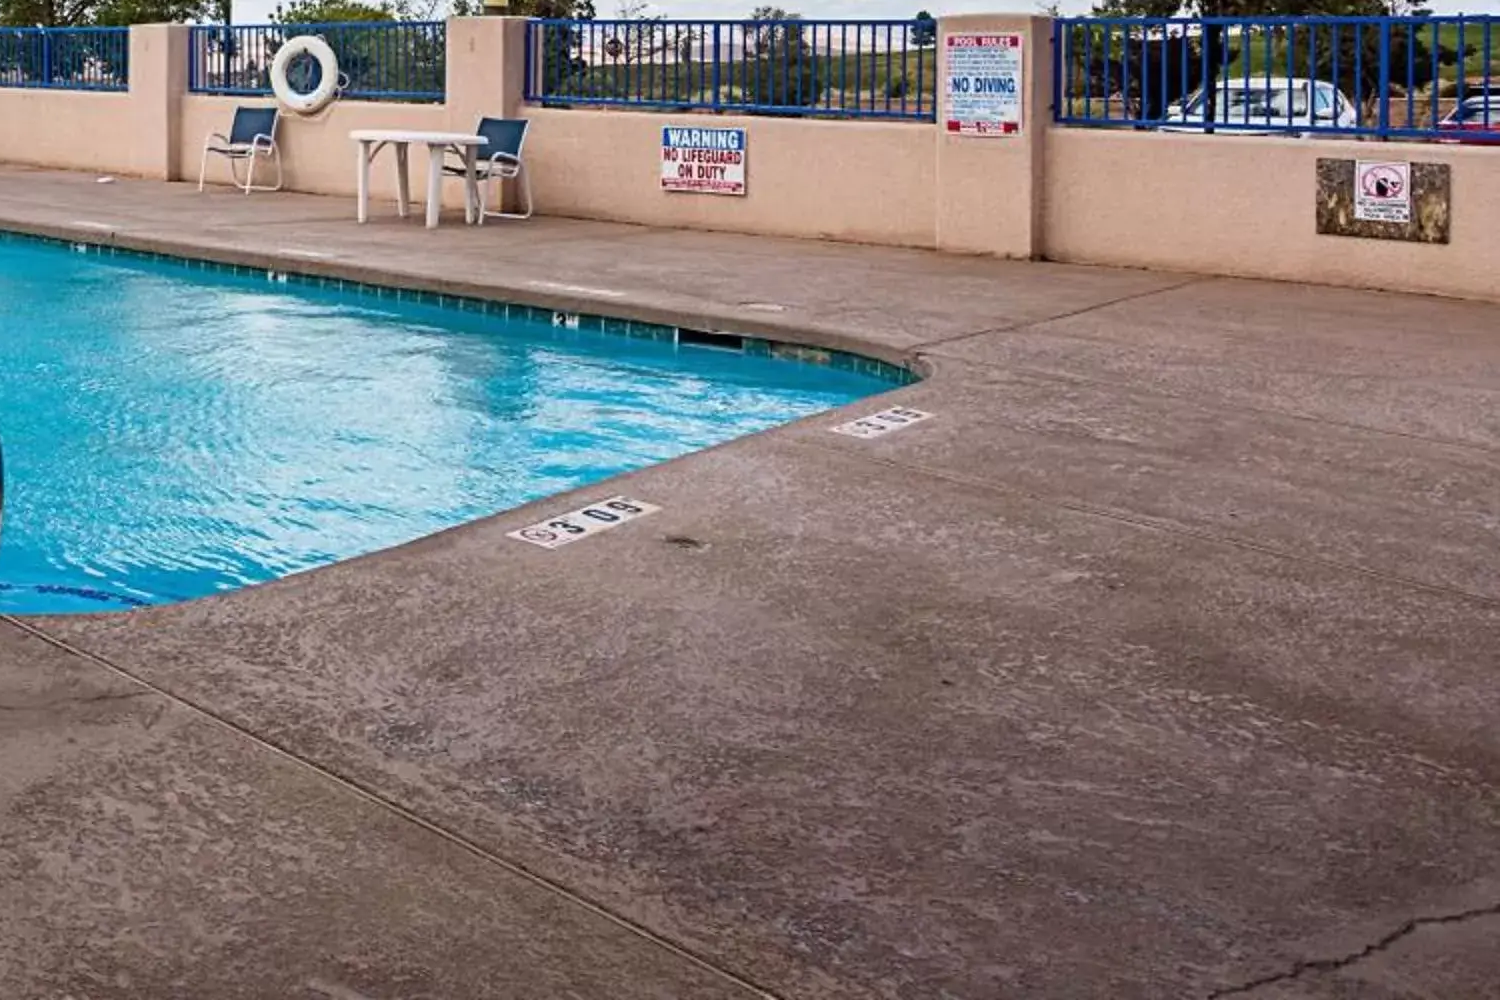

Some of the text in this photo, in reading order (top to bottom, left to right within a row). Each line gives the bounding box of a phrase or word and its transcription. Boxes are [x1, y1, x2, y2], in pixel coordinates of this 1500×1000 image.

[952, 77, 1015, 93] NO DIVING
[668, 129, 739, 149] WARNING
[663, 147, 742, 165] NO LIFEGUARD
[677, 163, 727, 180] ON DUTY
